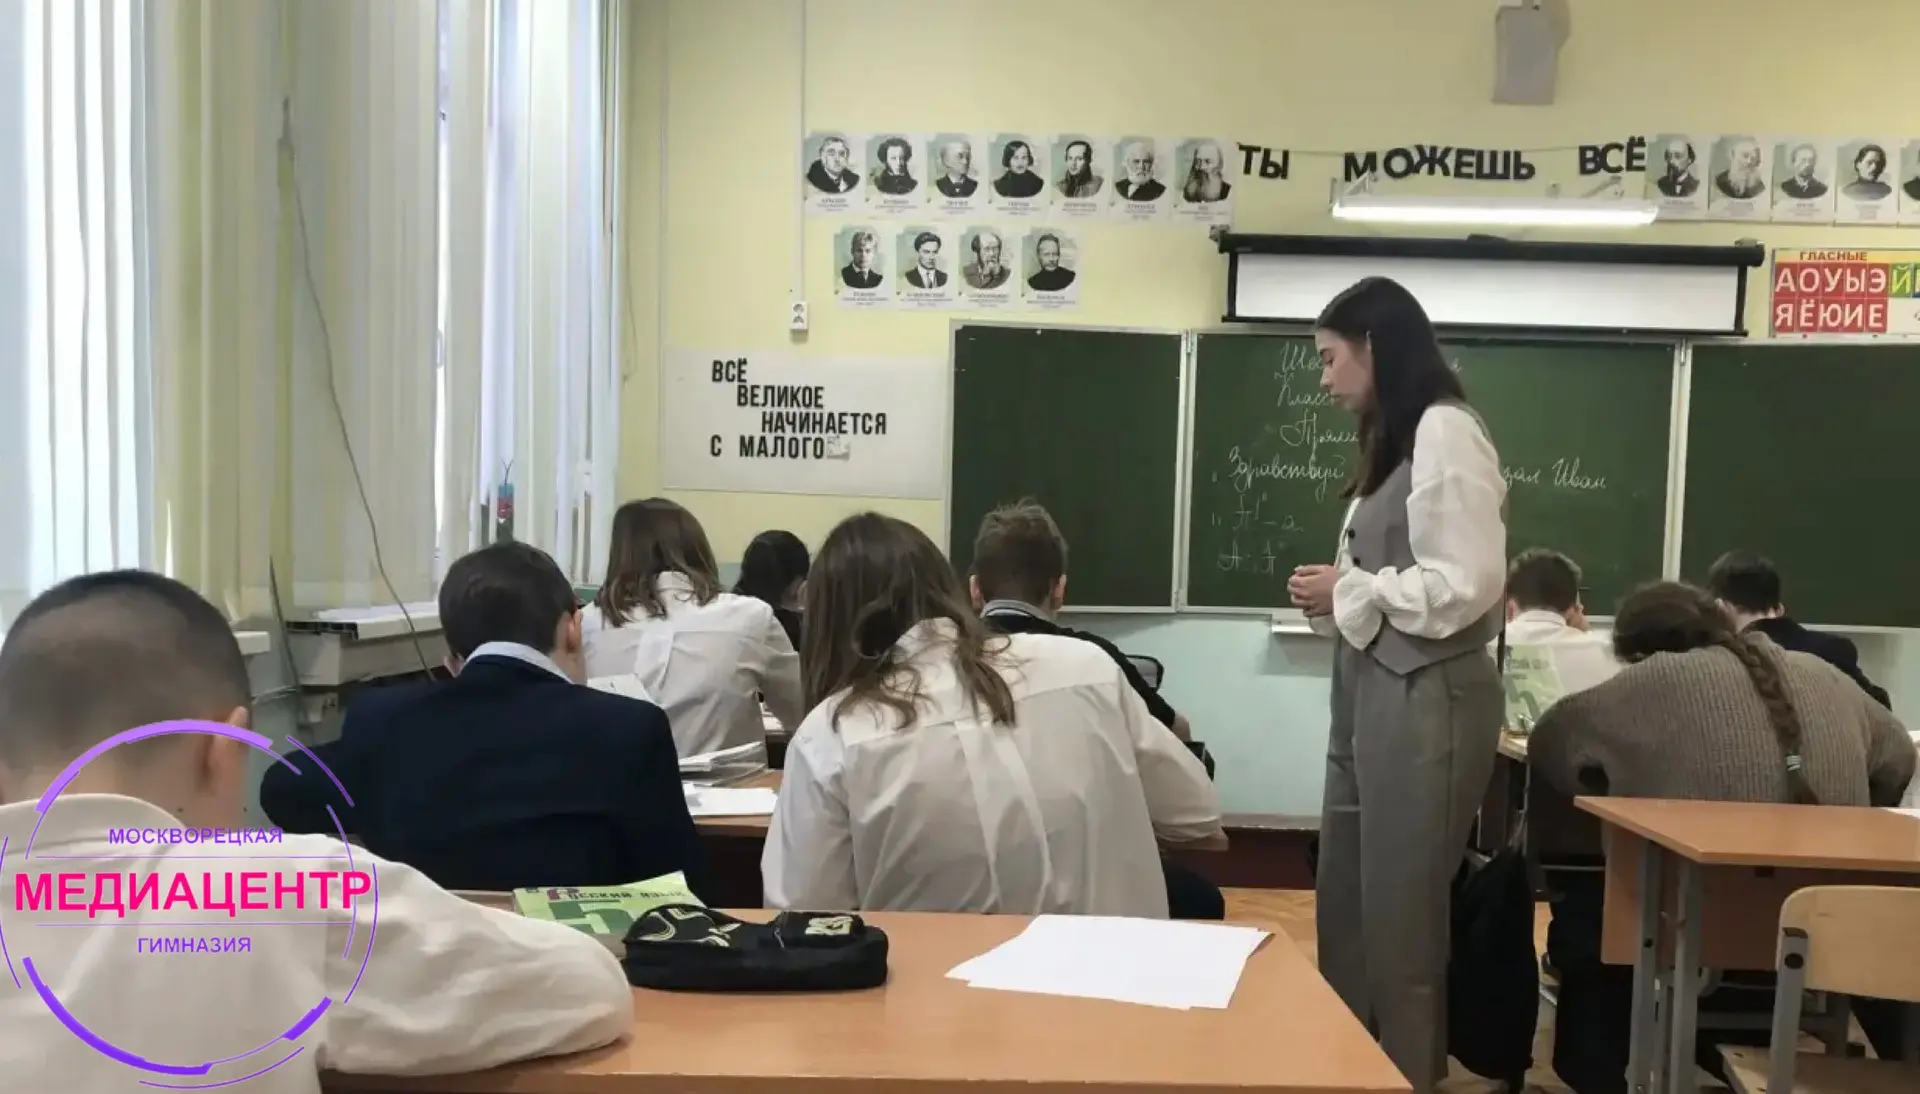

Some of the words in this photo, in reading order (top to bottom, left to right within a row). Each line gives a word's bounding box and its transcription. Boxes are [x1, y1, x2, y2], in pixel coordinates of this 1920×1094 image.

[1237, 142, 1289, 180] ТЫ
[1344, 144, 1535, 182] МОЖЕШЬ
[1578, 136, 1647, 175] ВСЁ
[1800, 251, 1868, 261] ГЛАСНЫЕ
[711, 358, 748, 383] ВСЁ
[737, 384, 824, 409] ВЕЛИКОЕ
[761, 411, 887, 435] НАЧИНАЕТСЯ
[710, 434, 722, 458] С
[739, 435, 825, 459] МАЛОГО
[1552, 456, 1606, 489] Иван
